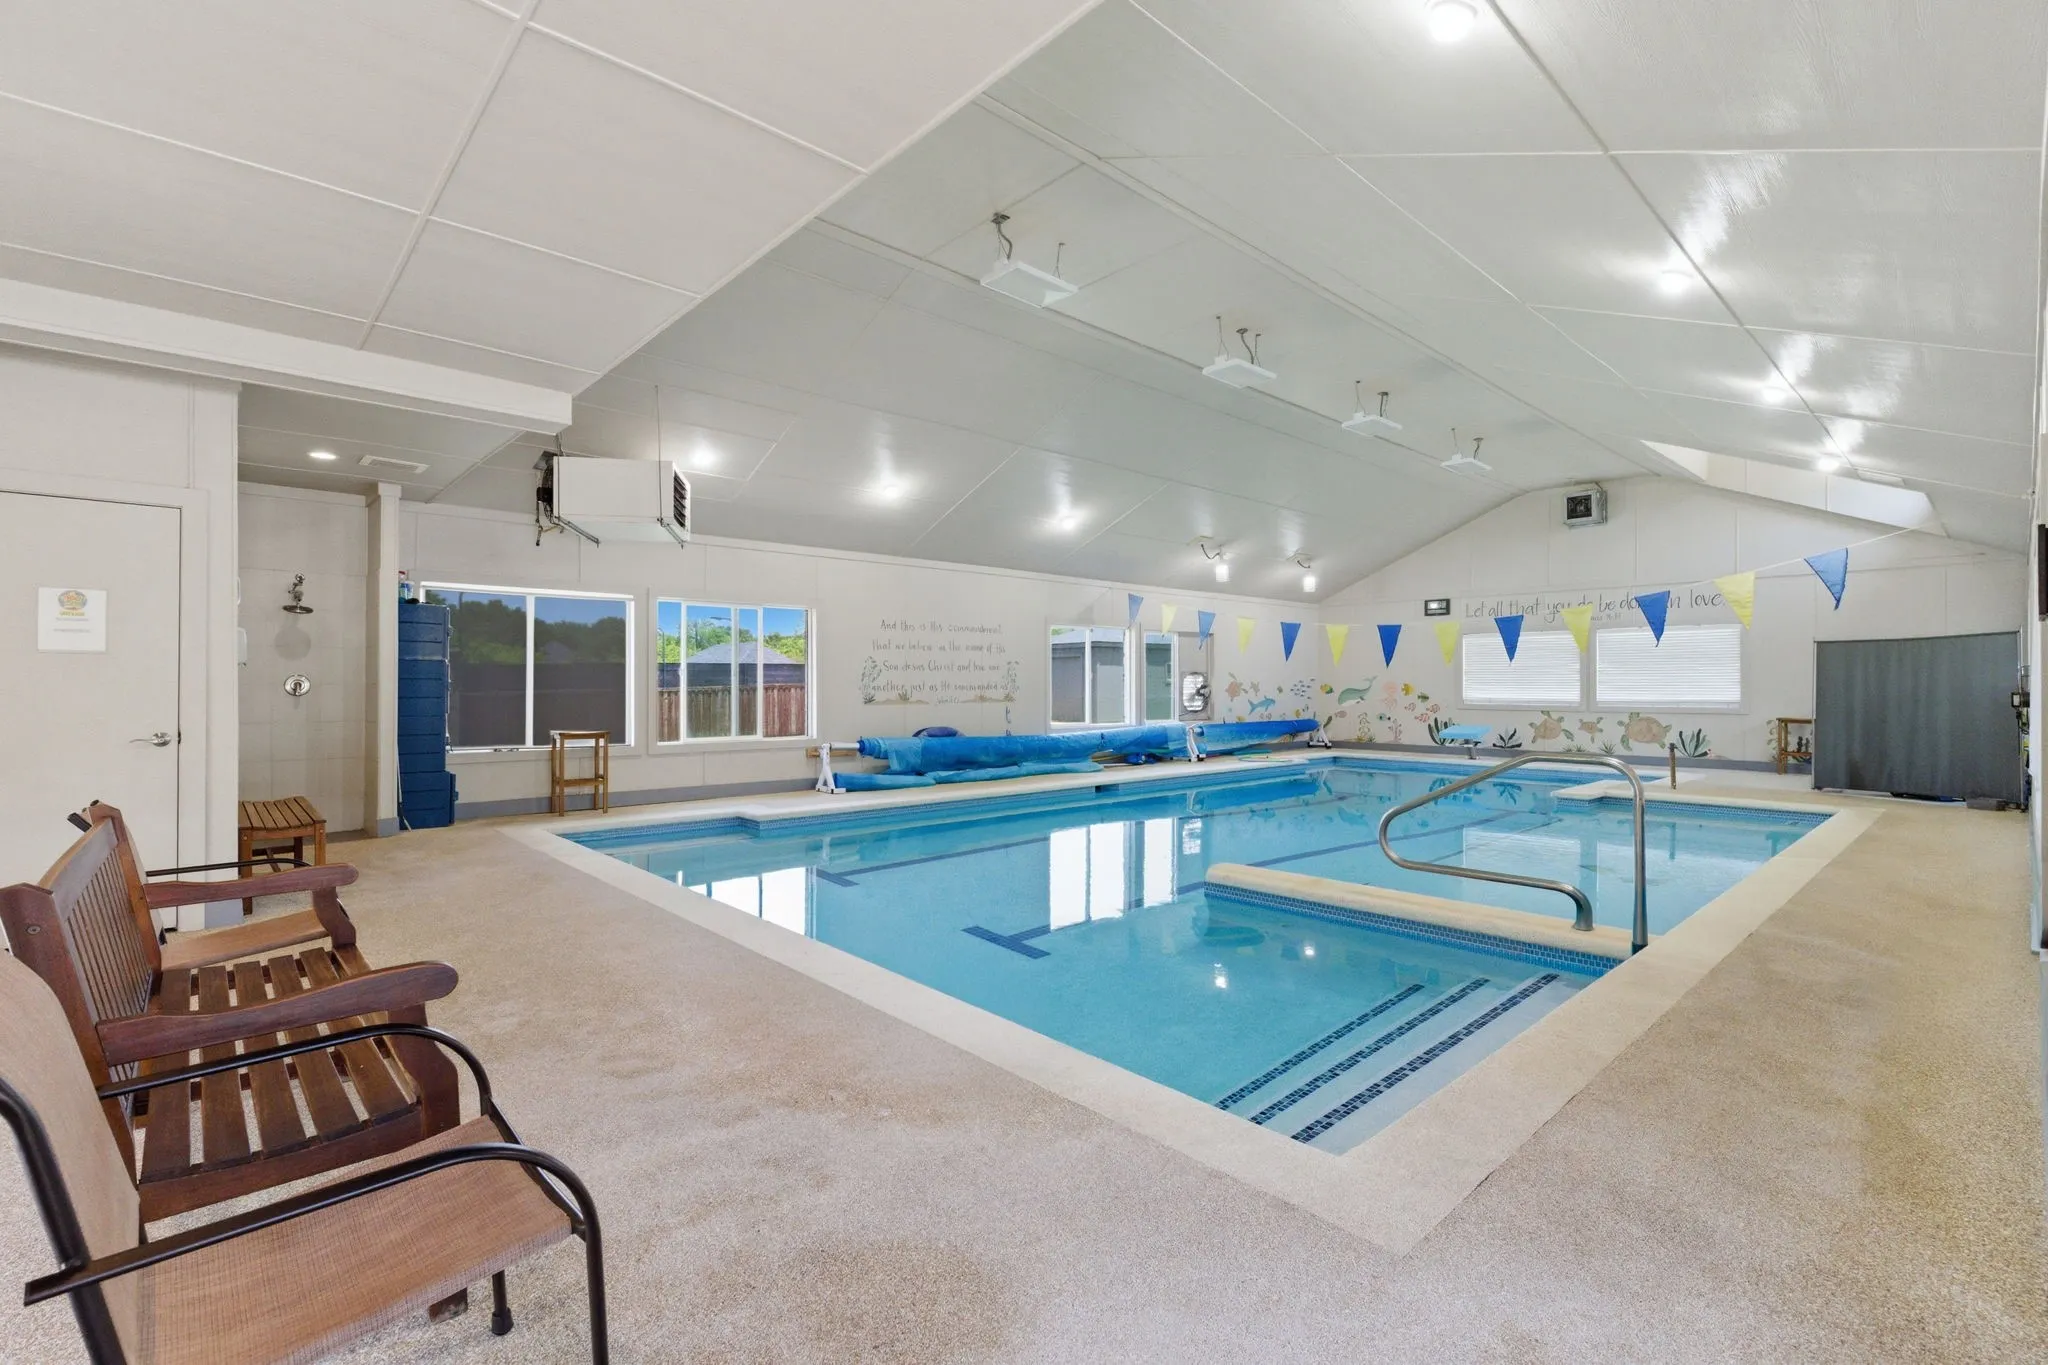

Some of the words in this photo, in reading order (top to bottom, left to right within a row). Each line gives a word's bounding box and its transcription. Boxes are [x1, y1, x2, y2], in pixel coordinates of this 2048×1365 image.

[1465, 600, 1485, 618] Let
[1488, 600, 1503, 617] all
[1509, 597, 1539, 616] that
[1544, 600, 1572, 624] you
[1599, 593, 1615, 613] be
[880, 619, 896, 631] And
[882, 660, 899, 672] Son
[928, 659, 953, 672] Christ
[957, 660, 971, 672] and
